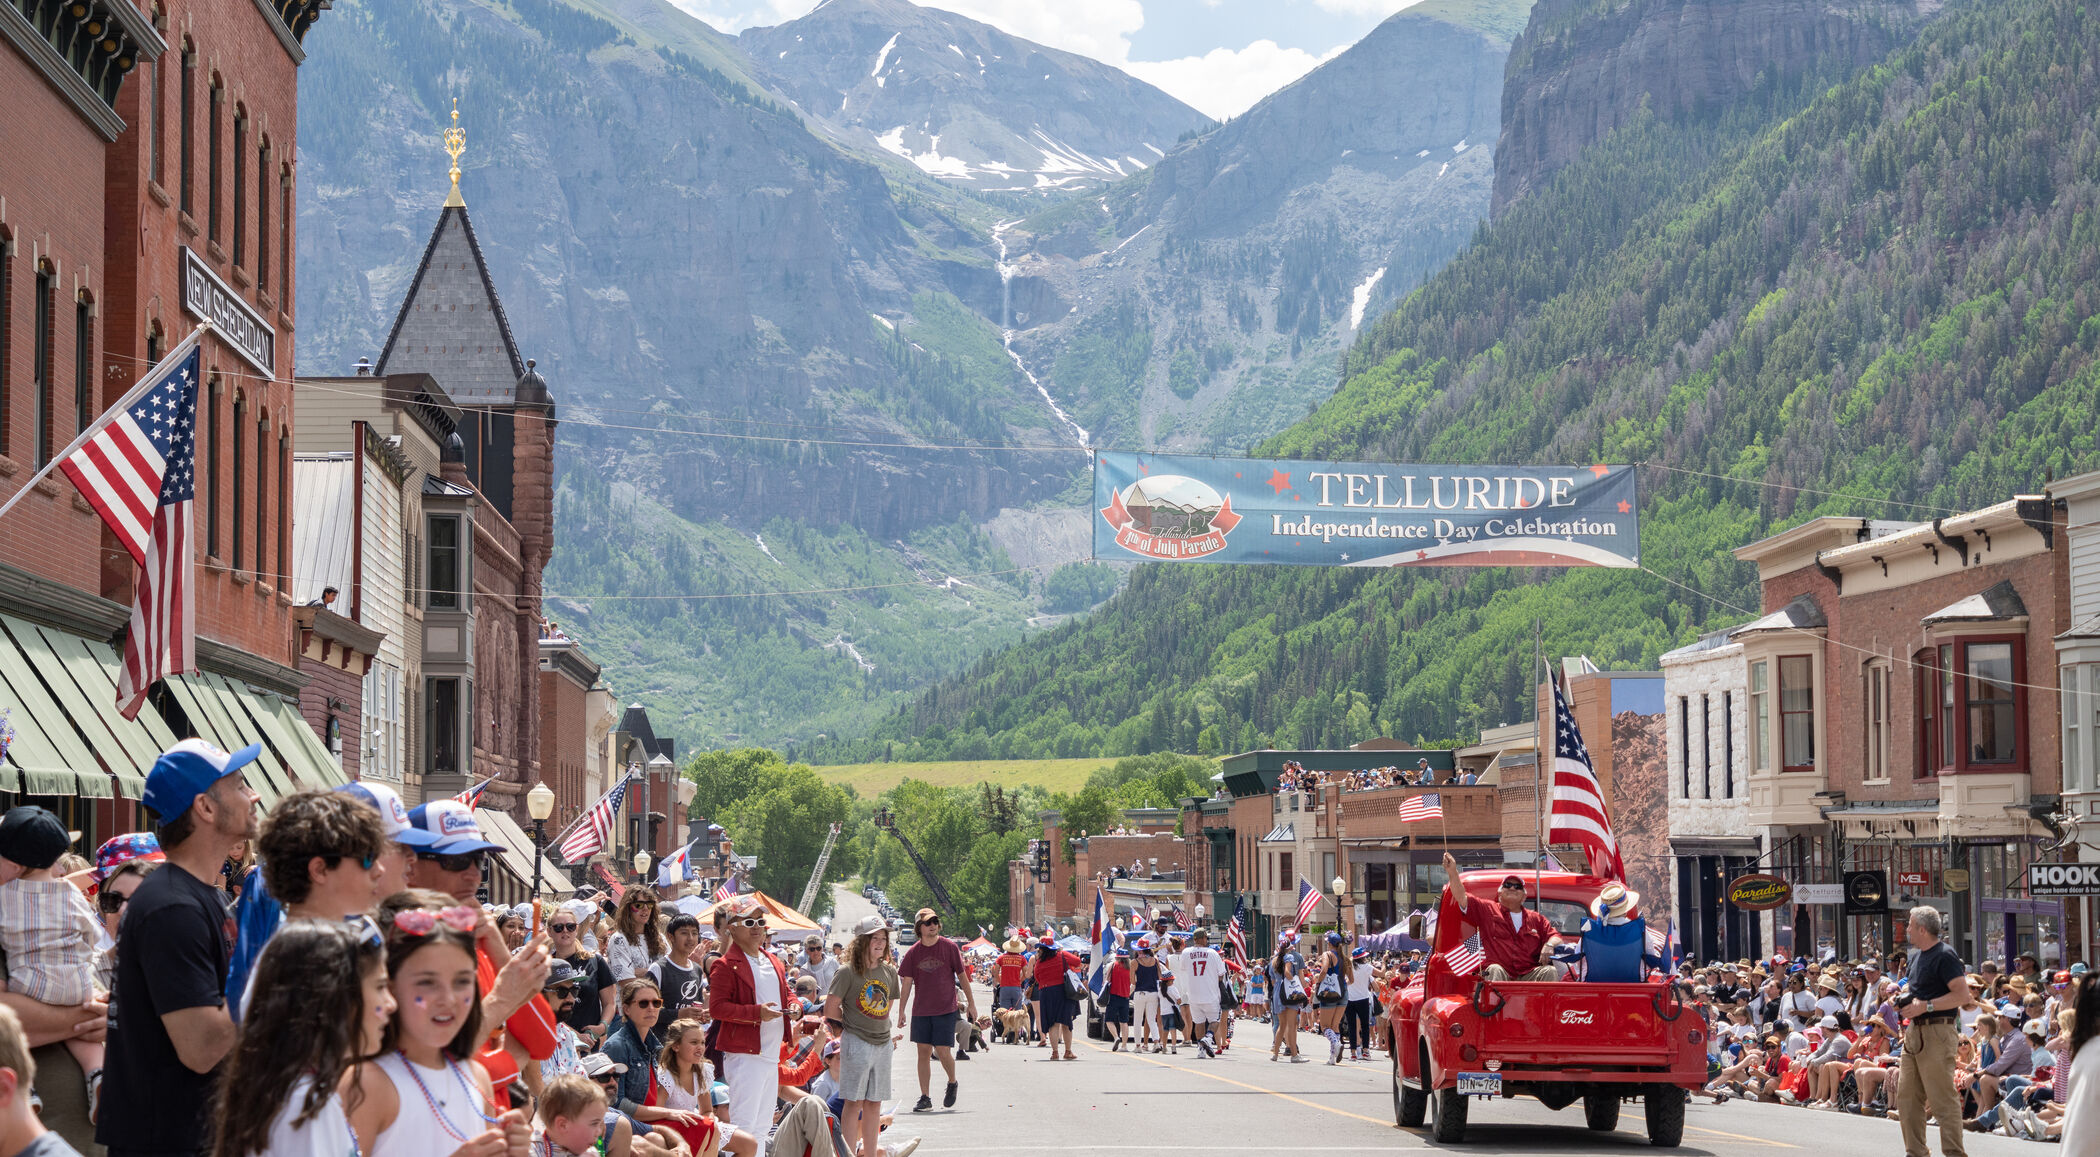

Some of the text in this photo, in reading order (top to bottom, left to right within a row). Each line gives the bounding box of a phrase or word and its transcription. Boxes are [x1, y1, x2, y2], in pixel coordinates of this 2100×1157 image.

[187, 265, 270, 368] NEW SHERIDAN
[1308, 472, 1577, 510] TELLURIDE
[1150, 526, 1198, 540] Telluride
[1271, 514, 1618, 544] Independence Day Celebration
[1123, 531, 1220, 558] 4th of July Parade
[1900, 874, 1927, 884] MSL
[2031, 866, 2100, 886] HOOK
[1732, 883, 1788, 902] Paradise
[1192, 960, 1207, 976] 17
[1560, 1009, 1594, 1024] Ford
